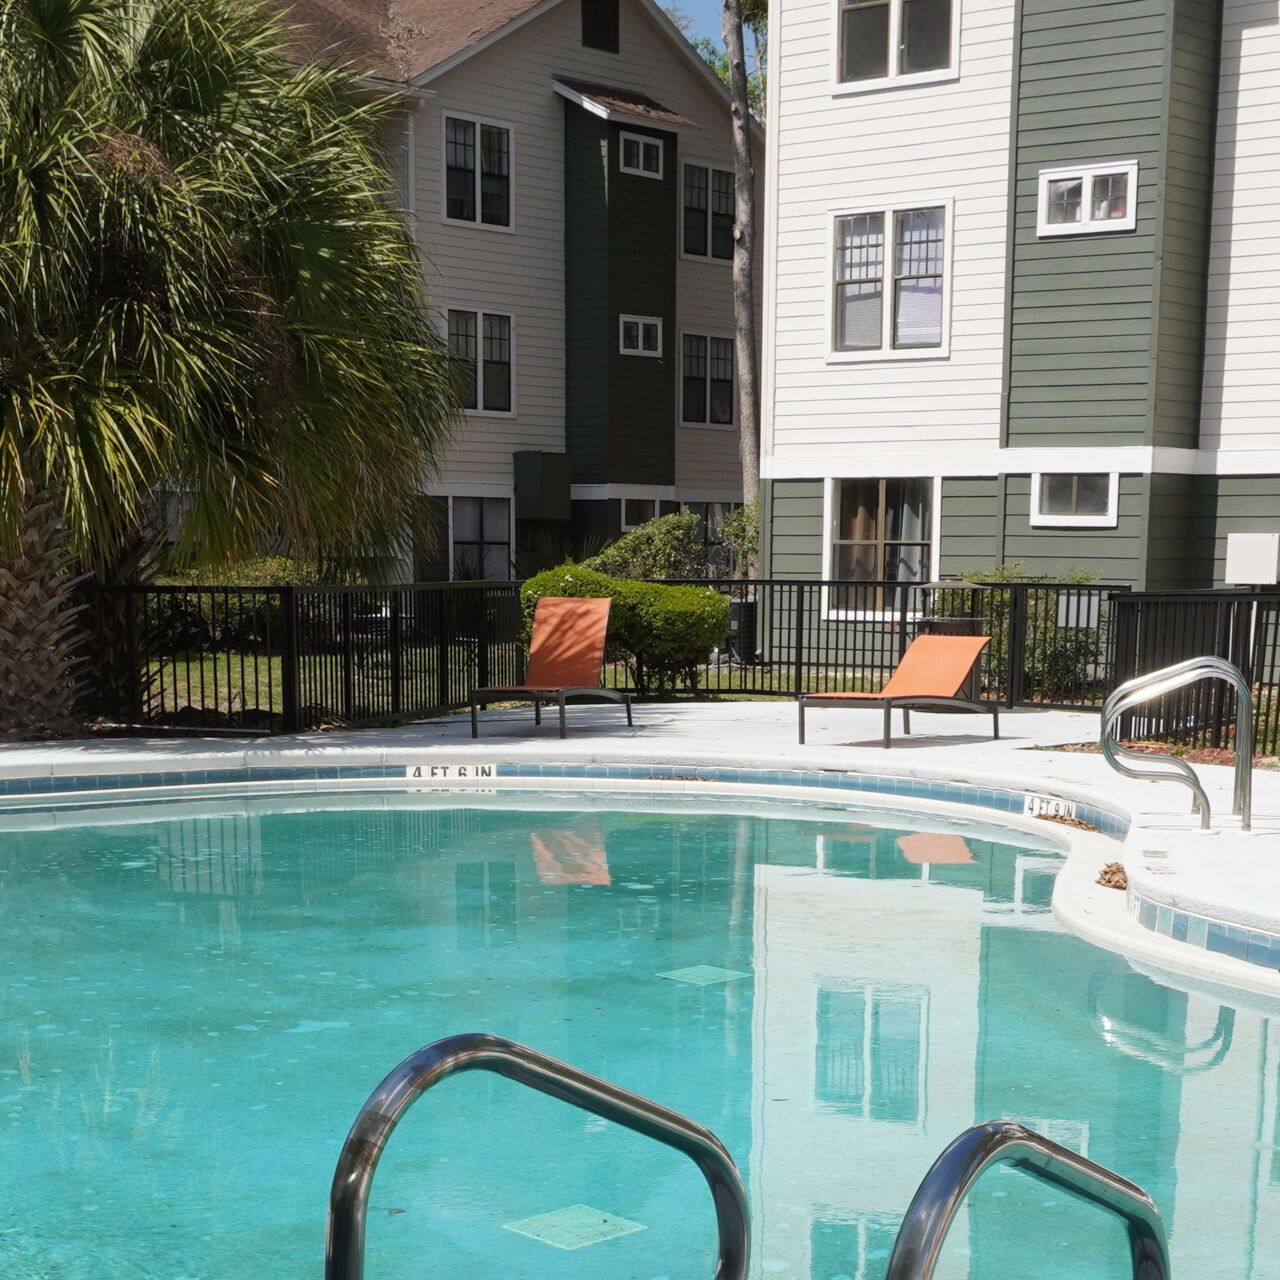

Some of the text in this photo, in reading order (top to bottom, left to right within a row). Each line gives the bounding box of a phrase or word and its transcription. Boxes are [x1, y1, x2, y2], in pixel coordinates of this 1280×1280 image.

[413, 766, 422, 777] 4
[431, 766, 449, 777] FT
[475, 766, 492, 777] IN
[1028, 797, 1073, 818] 4 FT 9 IN
